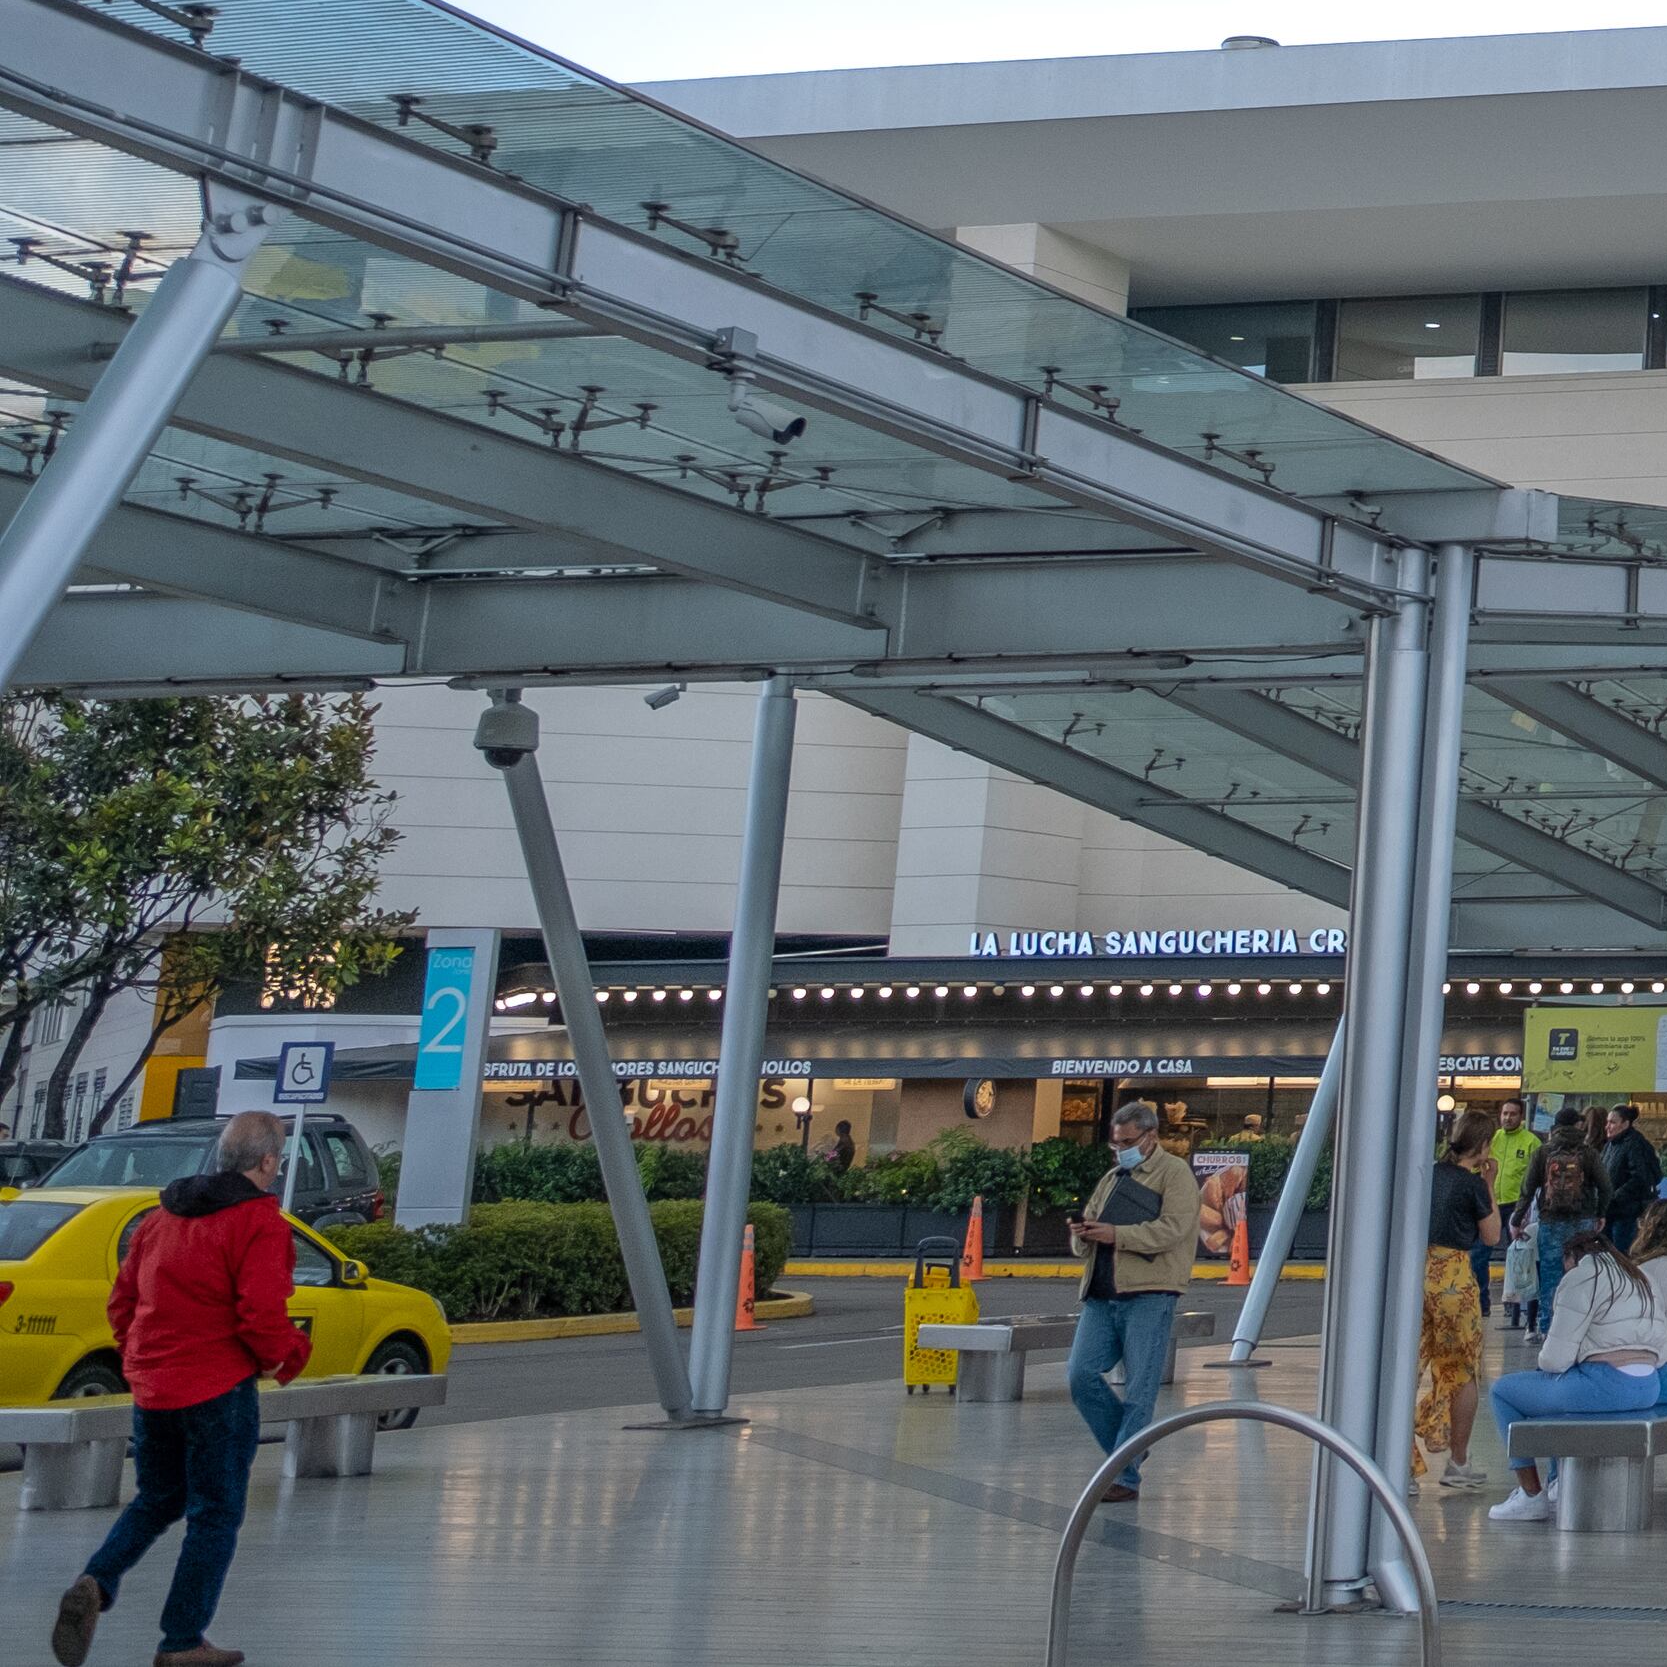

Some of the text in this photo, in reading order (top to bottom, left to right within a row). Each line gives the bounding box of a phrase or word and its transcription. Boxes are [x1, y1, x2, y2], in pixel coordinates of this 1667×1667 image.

[969, 928, 1346, 956] LA LUCHA SANGUCHERIA CR
[432, 953, 472, 969] Zona
[423, 986, 466, 1053] 2
[484, 1060, 812, 1077] SFRUTA DE LO ORES SANGUCH IOLLOS
[1051, 1059, 1193, 1074] BIENVENIDO A CASA
[1438, 1056, 1491, 1072] ESCATE
